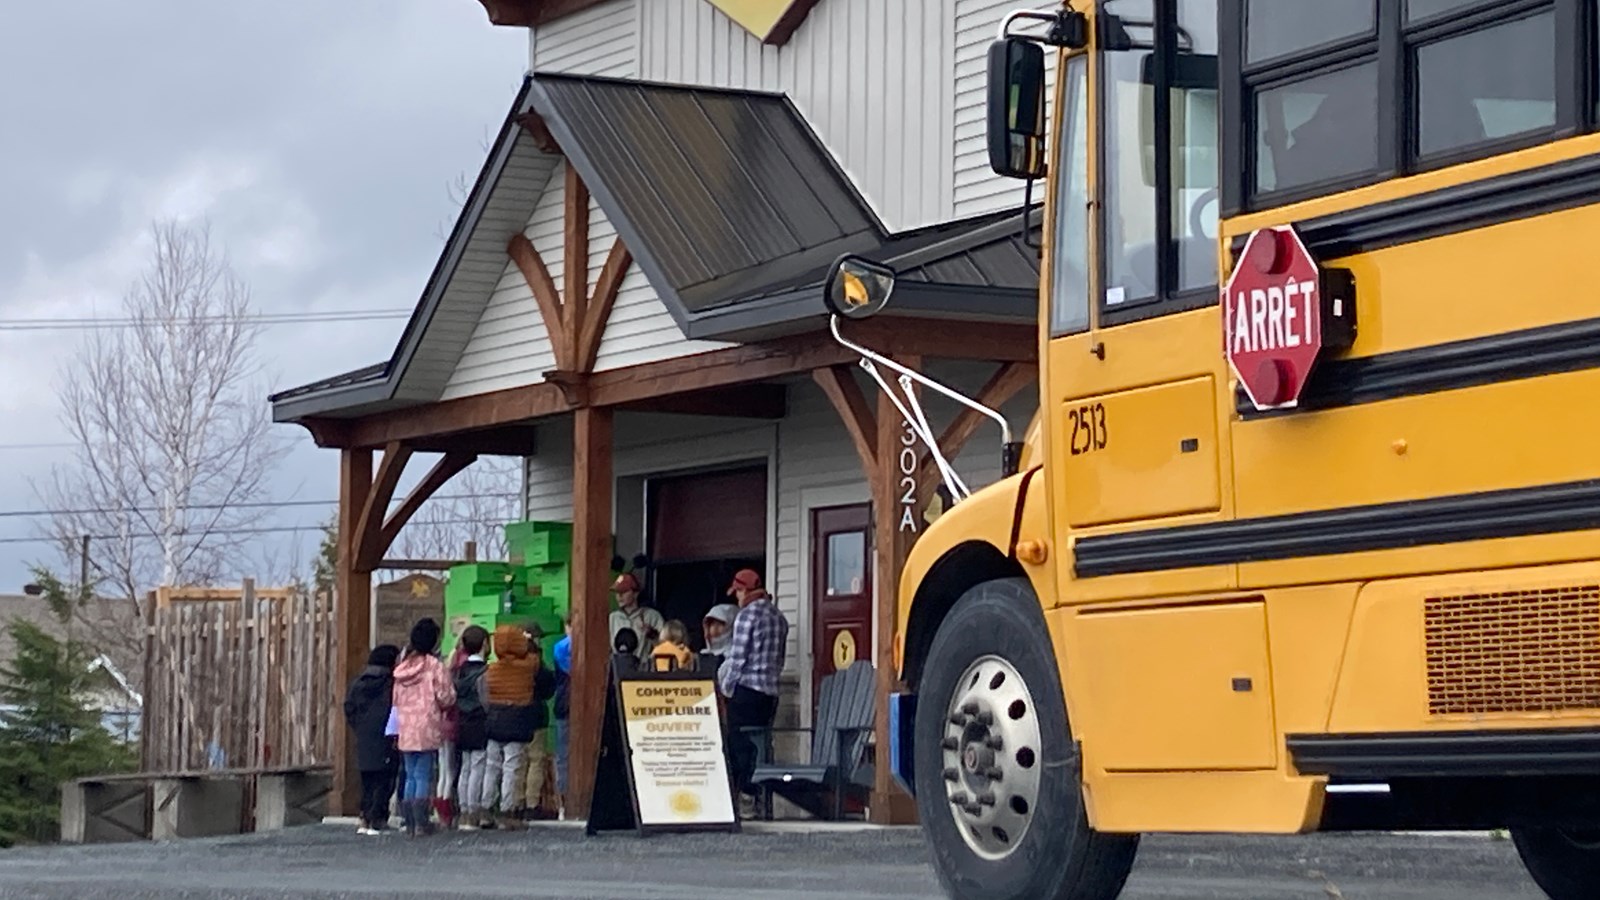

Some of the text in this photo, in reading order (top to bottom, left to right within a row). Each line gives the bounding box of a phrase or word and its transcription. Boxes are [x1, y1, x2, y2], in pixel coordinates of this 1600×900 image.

[1234, 276, 1315, 354] ARRÊT
[1069, 403, 1107, 456] 2513
[899, 420, 917, 533] 302A
[636, 687, 702, 697] COMPTOIR
[631, 706, 711, 716] VENTE LIBRE
[646, 722, 702, 733] OUVERT
